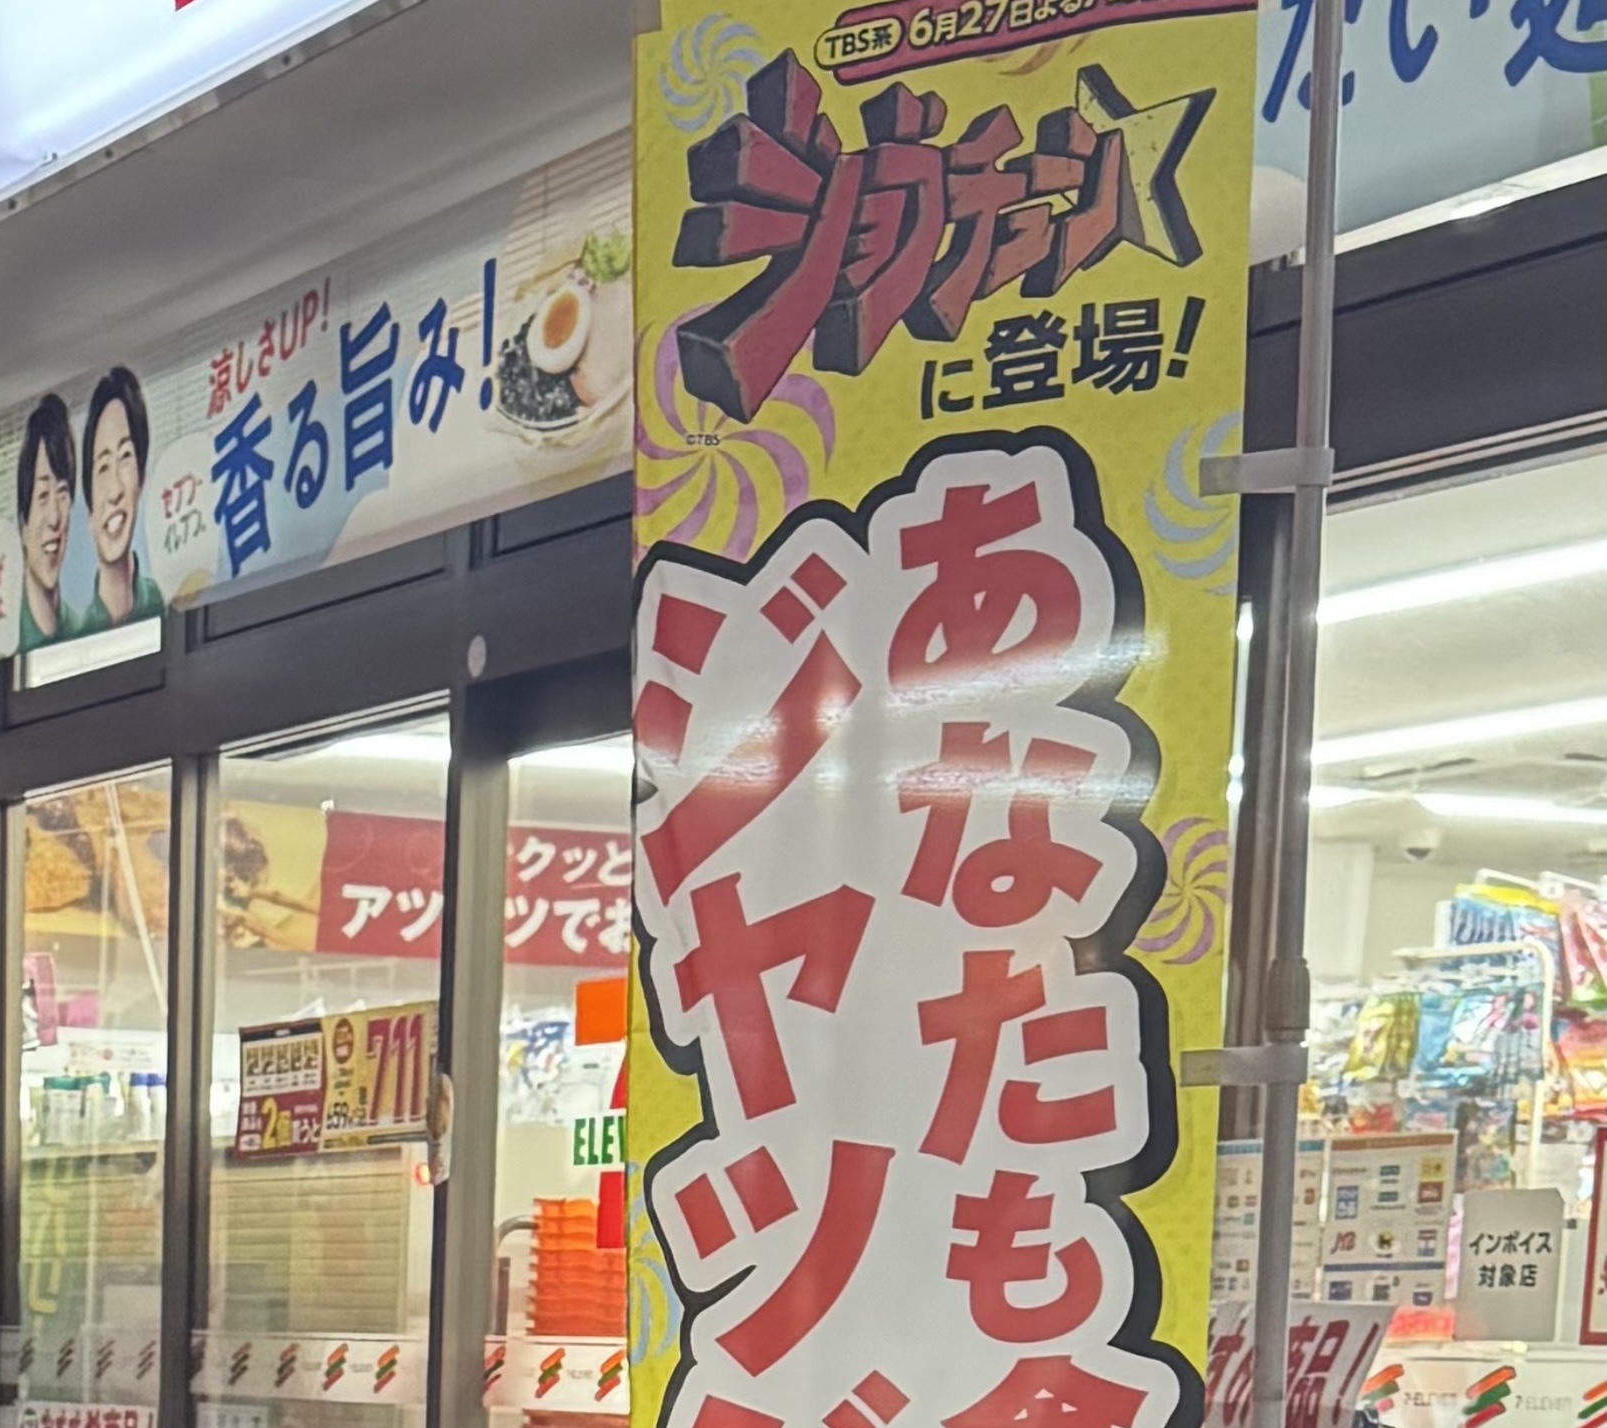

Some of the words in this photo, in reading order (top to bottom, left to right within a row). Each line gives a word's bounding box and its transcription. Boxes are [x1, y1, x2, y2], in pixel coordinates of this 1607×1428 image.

[824, 26, 895, 58] TBS系
[908, 0, 1094, 46] 6月27日よる
[207, 277, 331, 418] 涼しさUP!
[921, 298, 1205, 419] に登場!
[210, 257, 497, 578] 香る旨み!
[506, 835, 632, 886] クッと
[341, 883, 632, 955] アツツでお
[1478, 1264, 1538, 1288] 対象店
